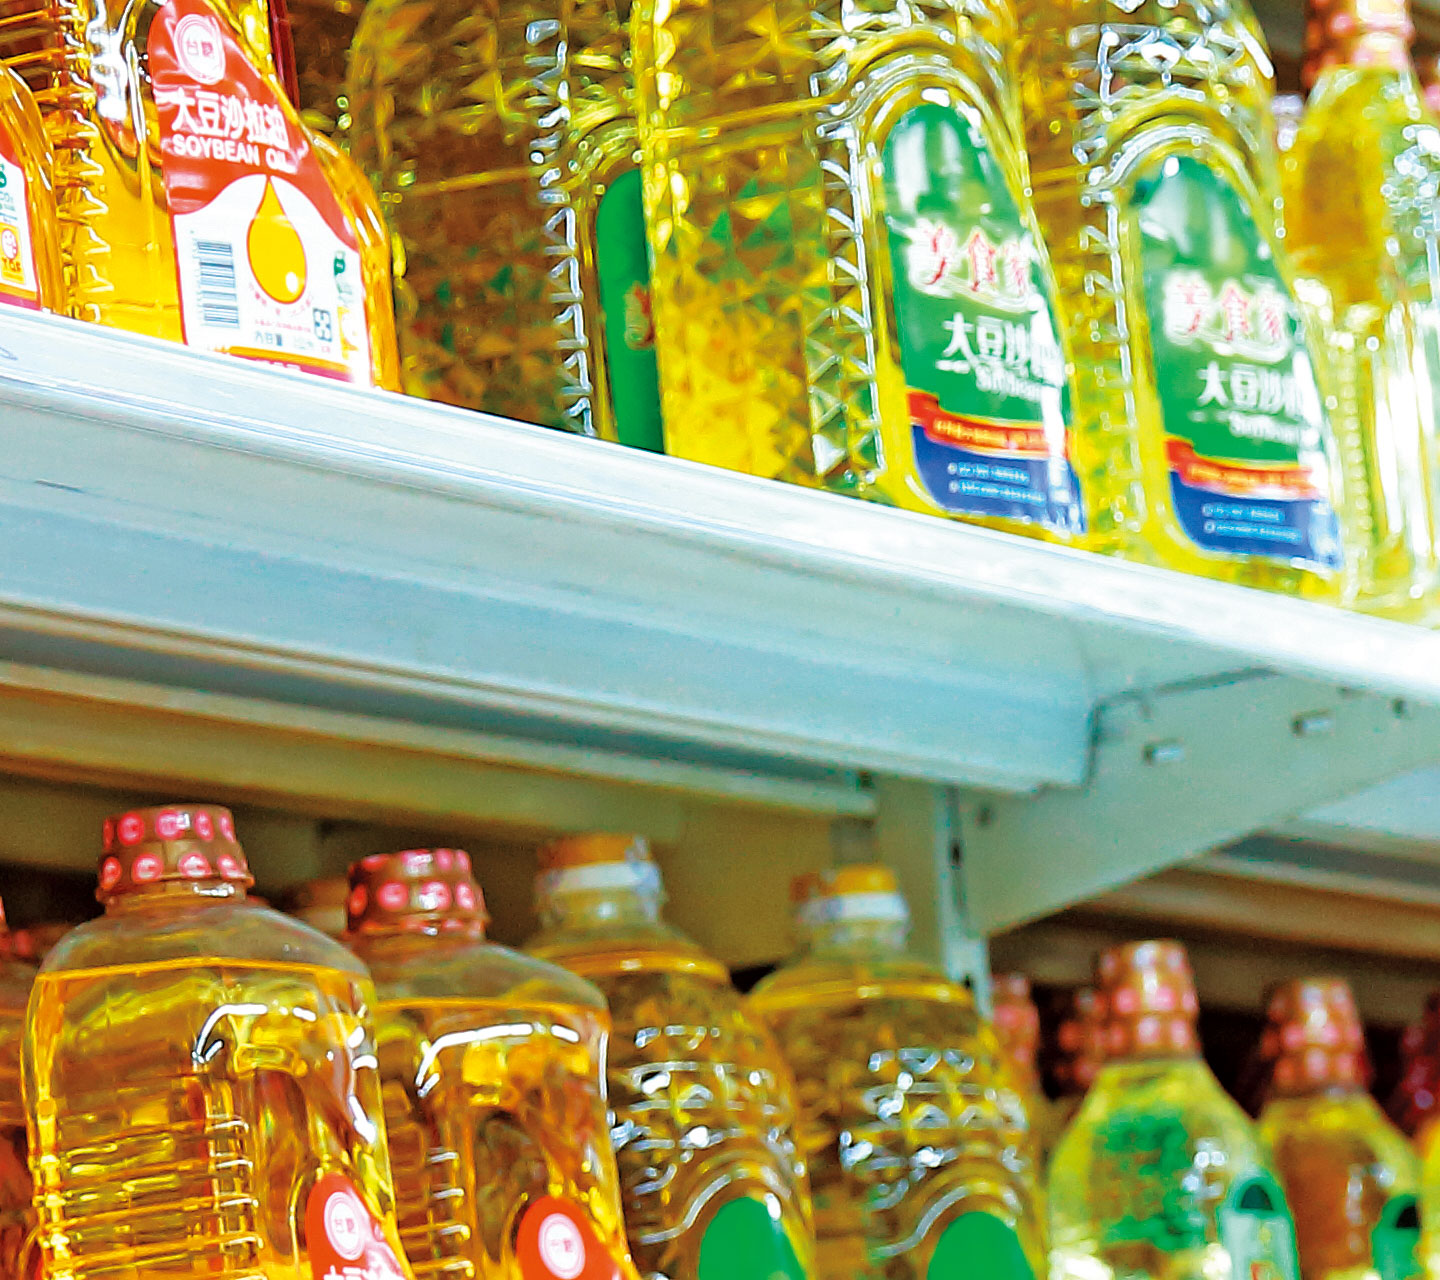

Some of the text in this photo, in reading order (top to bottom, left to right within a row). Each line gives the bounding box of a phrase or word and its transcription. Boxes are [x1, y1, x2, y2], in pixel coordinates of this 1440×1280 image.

[172, 87, 290, 151] 大豆沙拉油
[173, 135, 260, 166] SOYBEAN
